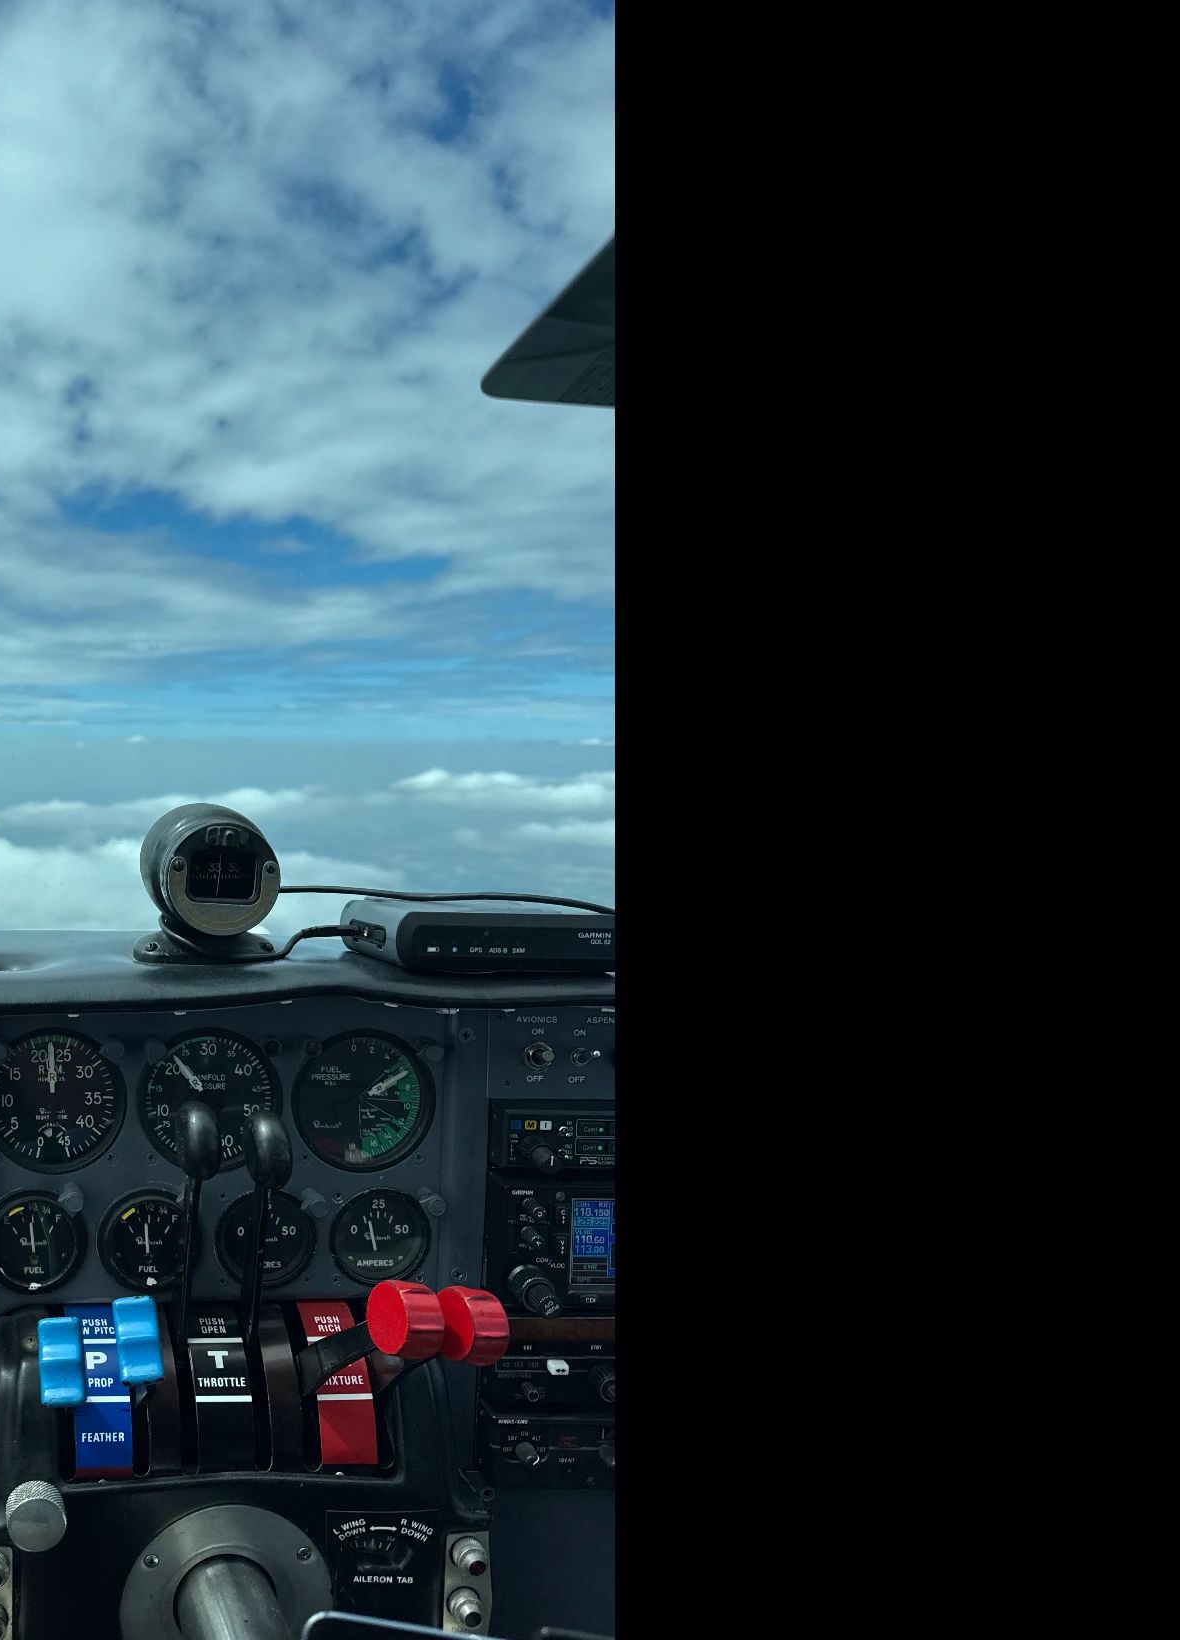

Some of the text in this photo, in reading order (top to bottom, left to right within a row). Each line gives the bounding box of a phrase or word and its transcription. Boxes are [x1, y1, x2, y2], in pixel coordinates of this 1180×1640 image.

[56, 1049, 71, 1062] 25
[199, 1044, 217, 1056] 30
[10, 1068, 21, 1080] 15
[76, 1066, 93, 1079] 30
[234, 1064, 252, 1076] 40
[2, 1094, 14, 1107] 10
[84, 1092, 102, 1105] 35
[157, 1104, 169, 1116] 10
[11, 1117, 19, 1130] 5
[76, 1115, 94, 1128] 40
[58, 1136, 70, 1146] 45
[372, 1200, 385, 1208] 25
[575, 1208, 609, 1217] 118.150
[282, 1226, 296, 1235] 50
[394, 1225, 409, 1234] 50
[314, 1316, 340, 1324] PUSH
[318, 1324, 341, 1332] RICH
[86, 1352, 107, 1369] P
[207, 1351, 228, 1369] T
[88, 1378, 113, 1388] PROP
[198, 1377, 246, 1387] THROTTLE
[82, 1432, 124, 1442] FEATHER
[341, 1518, 366, 1531] WING
[411, 1521, 434, 1535] WING
[339, 1526, 366, 1541] DOWN
[401, 1527, 429, 1543] DOWN
